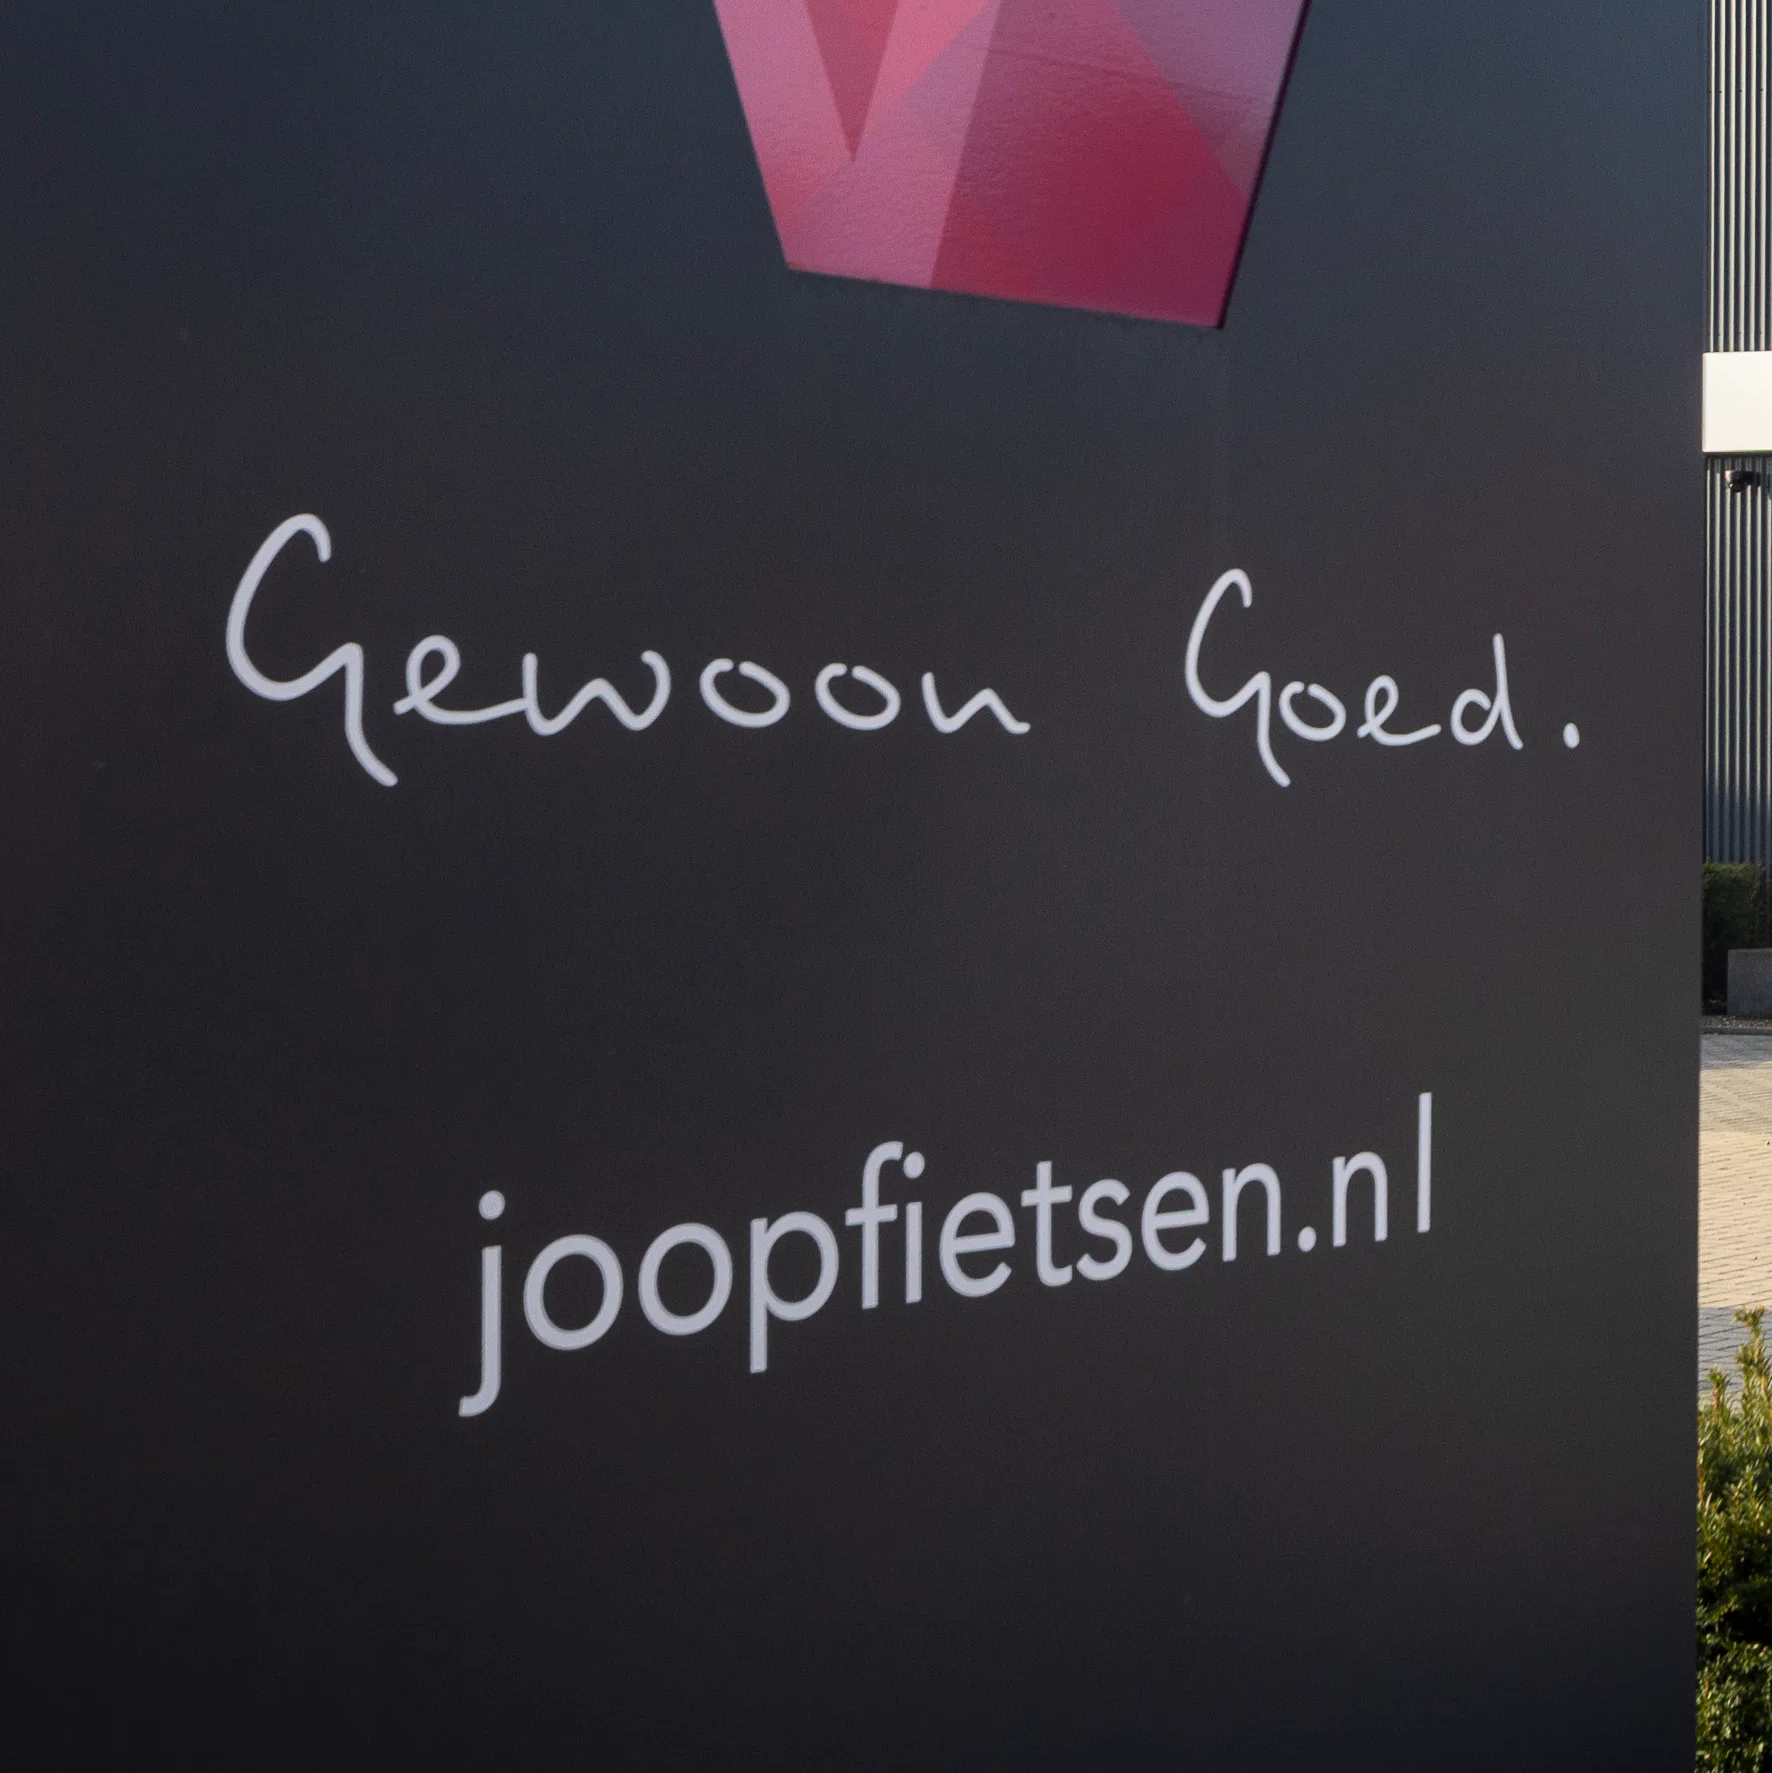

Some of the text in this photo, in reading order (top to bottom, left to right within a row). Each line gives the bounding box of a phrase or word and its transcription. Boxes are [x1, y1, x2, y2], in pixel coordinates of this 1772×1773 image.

[223, 512, 1581, 787] Gewoon Goed.
[457, 1090, 1432, 1417] joopfietsen.nl
